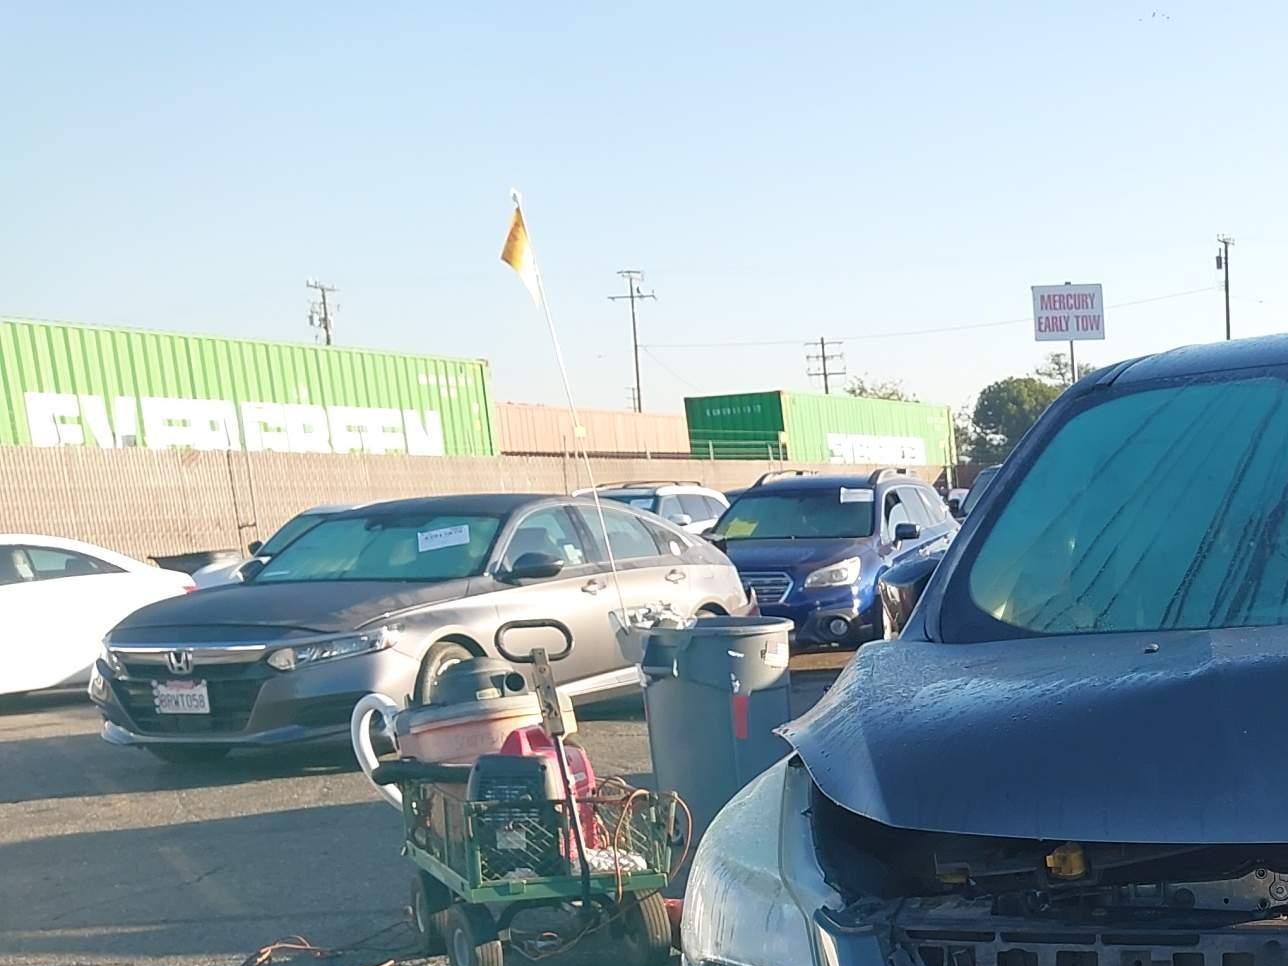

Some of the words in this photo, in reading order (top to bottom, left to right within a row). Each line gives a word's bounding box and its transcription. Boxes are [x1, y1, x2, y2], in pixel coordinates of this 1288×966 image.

[1040, 293, 1095, 311] MERCURY
[1038, 315, 1070, 332] EARLY
[1074, 314, 1101, 331] TOW
